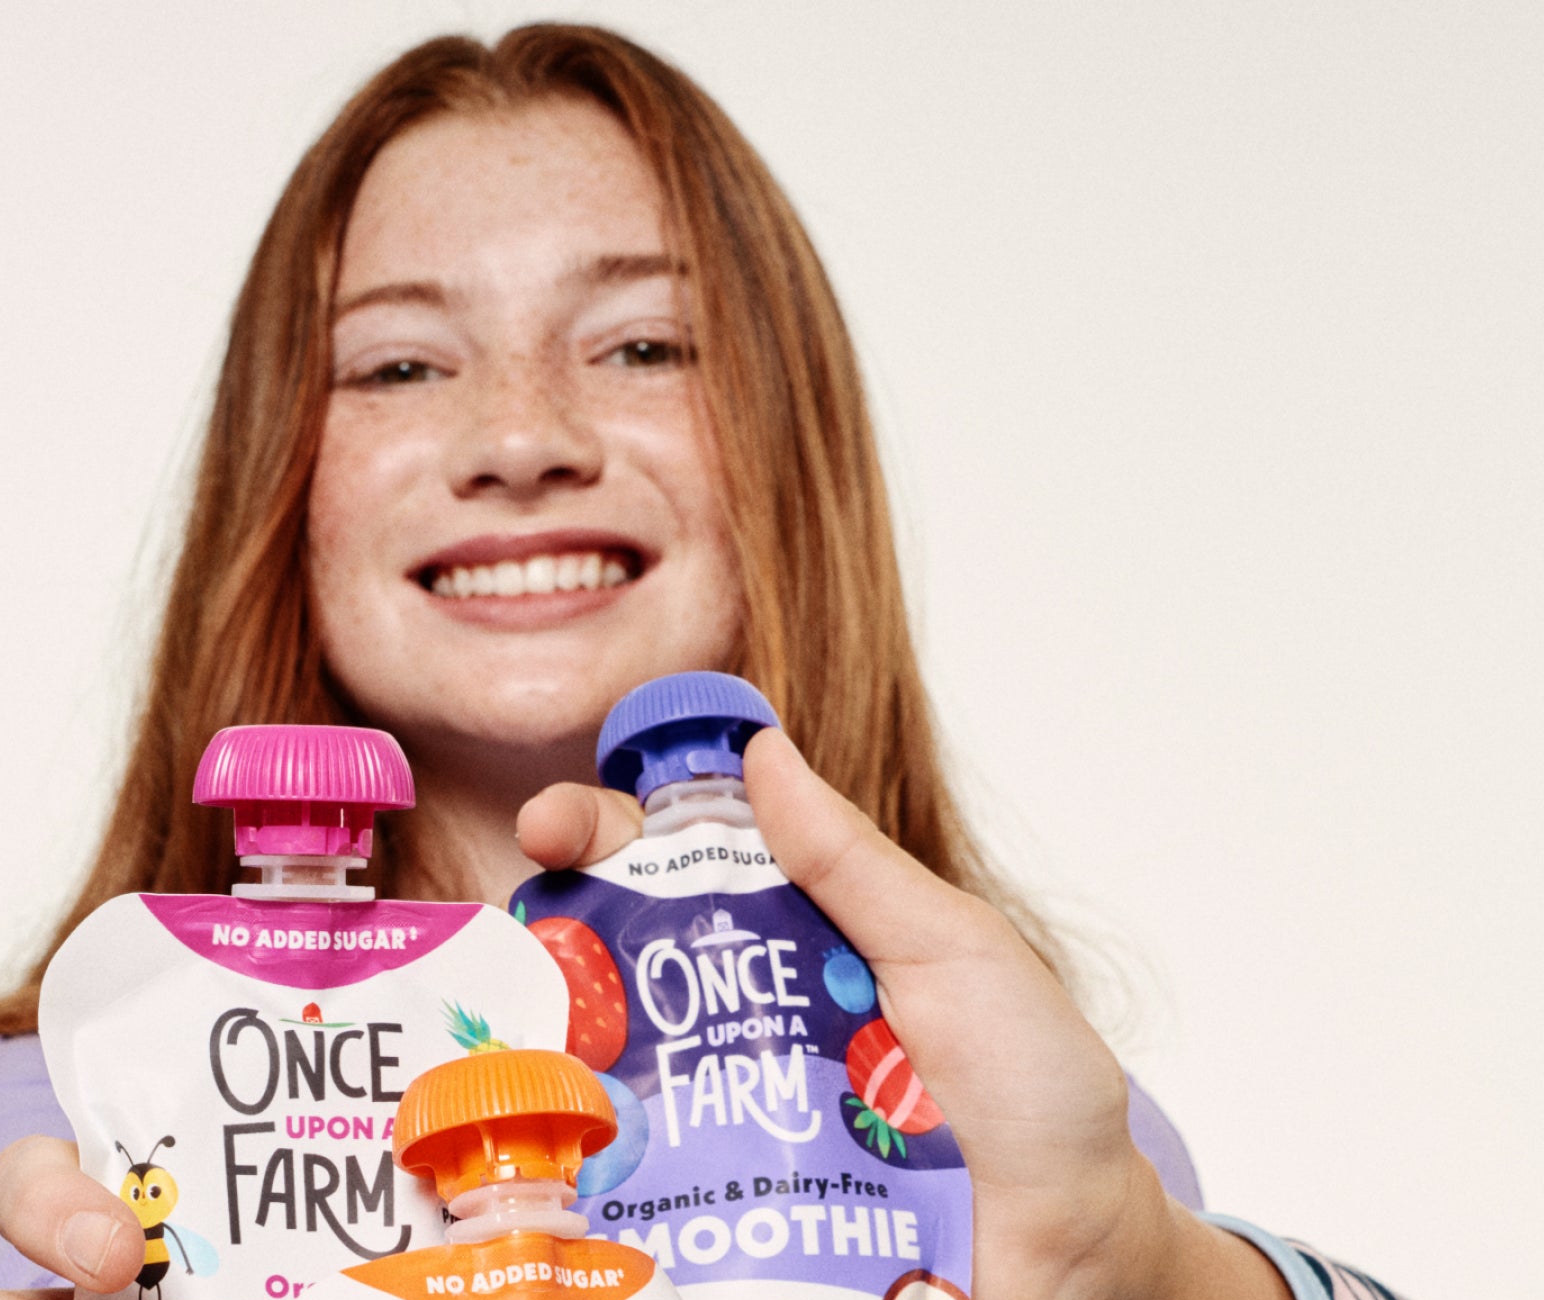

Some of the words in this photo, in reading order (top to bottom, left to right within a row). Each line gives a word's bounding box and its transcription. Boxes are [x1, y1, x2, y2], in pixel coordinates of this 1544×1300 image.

[628, 862, 659, 876] NO
[666, 847, 729, 873] ADDED
[212, 923, 250, 947] NO
[255, 928, 331, 950] ADDED
[636, 938, 810, 1035] ONCE
[707, 1015, 784, 1047] UPON
[789, 1015, 808, 1036] A
[209, 1007, 405, 1116] ONCE
[656, 1034, 822, 1147] FARM
[285, 1115, 374, 1140] UPON
[223, 1121, 412, 1262] FARM
[602, 1187, 715, 1220] Organic
[724, 1181, 744, 1201] &
[753, 1172, 888, 1199] Dairy-Free
[586, 1204, 921, 1270] MOOTHIE
[426, 1274, 465, 1295] NO
[471, 1262, 552, 1293] ADDED
